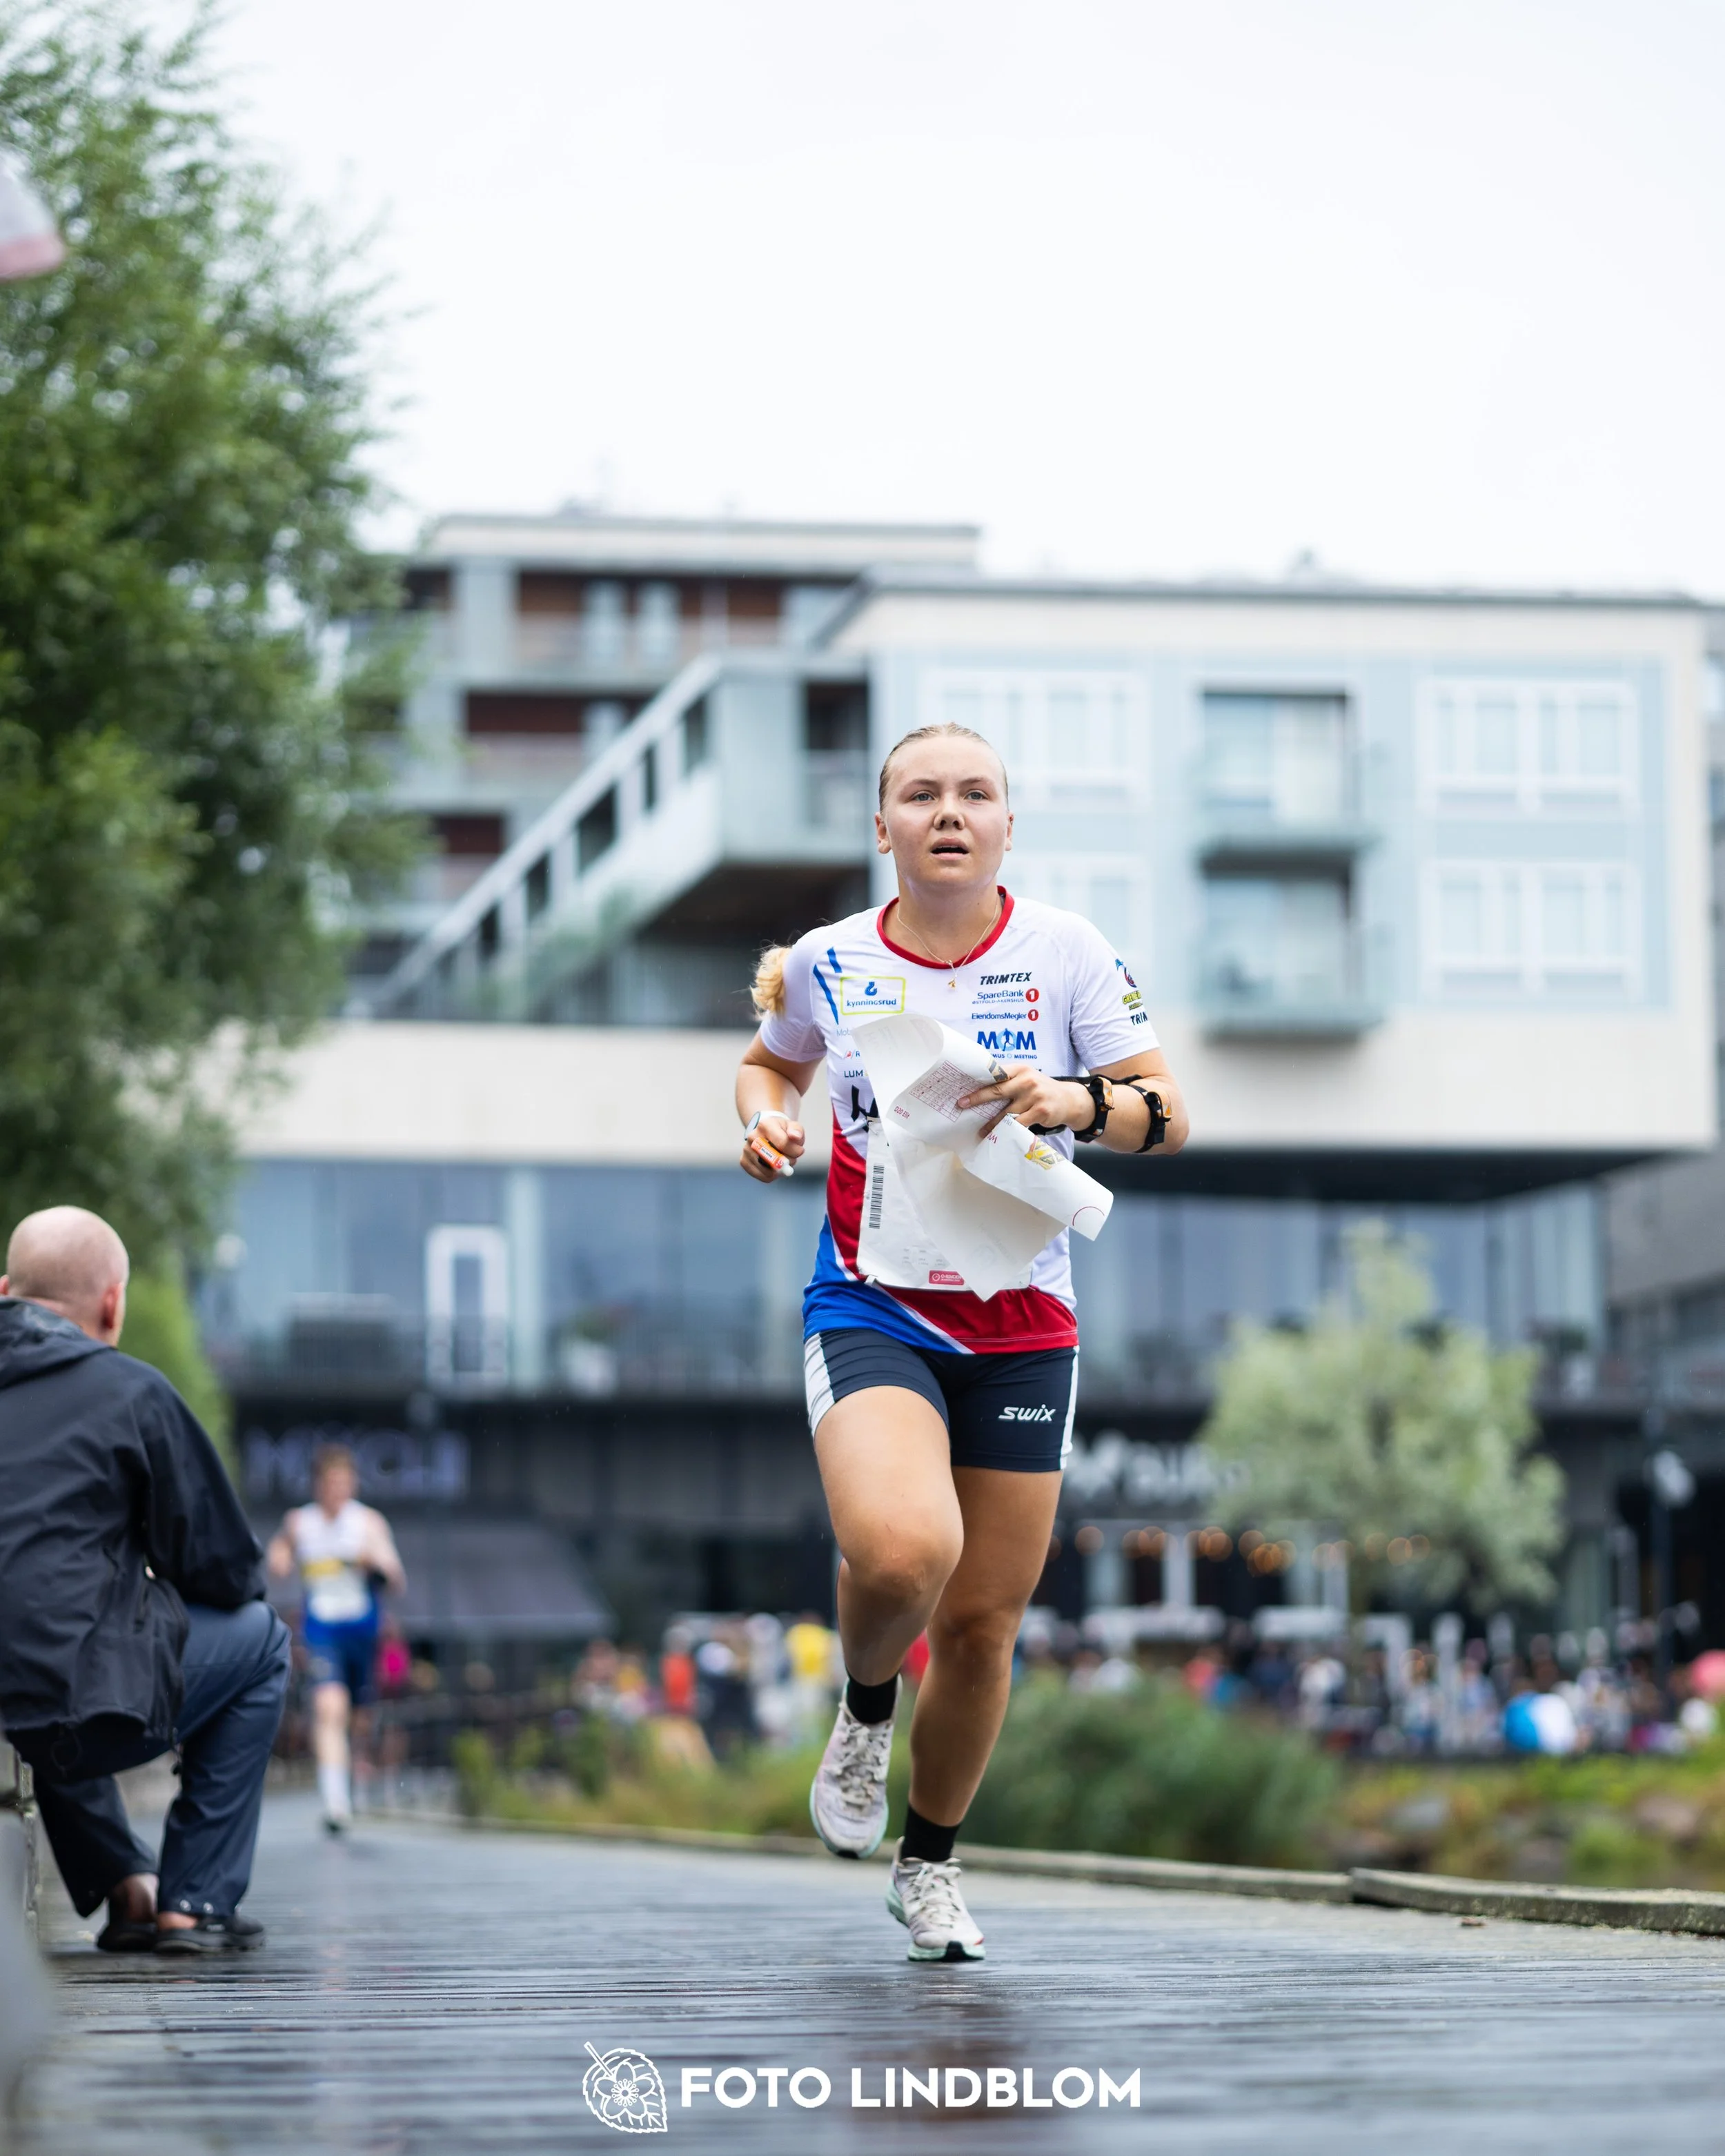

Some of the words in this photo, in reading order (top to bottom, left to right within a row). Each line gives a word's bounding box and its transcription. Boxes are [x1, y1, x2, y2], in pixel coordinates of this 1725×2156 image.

[980, 971, 1032, 985] TRIMTEX
[977, 989, 1024, 1000] SpareBank
[971, 1012, 1027, 1021] EiendomsMegler
[894, 1107, 903, 1115] D20
